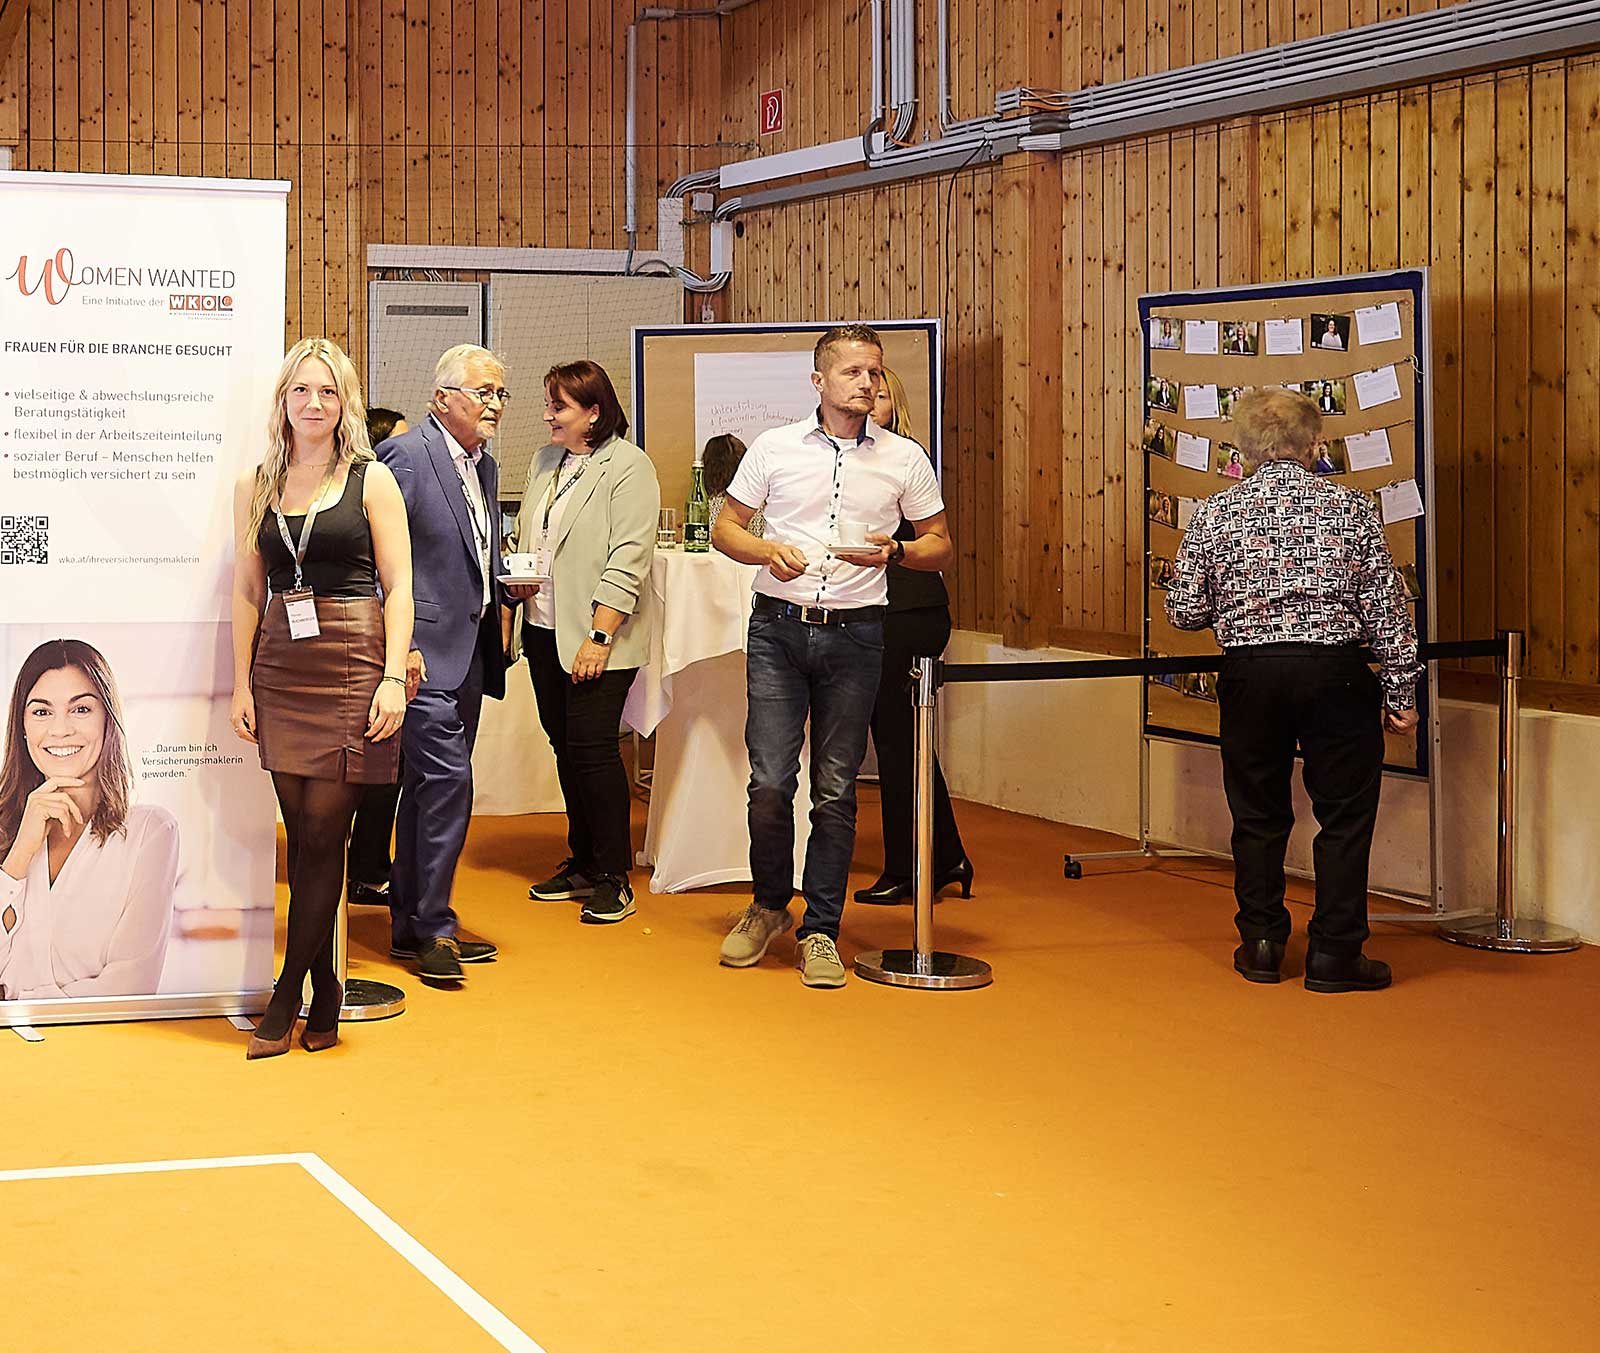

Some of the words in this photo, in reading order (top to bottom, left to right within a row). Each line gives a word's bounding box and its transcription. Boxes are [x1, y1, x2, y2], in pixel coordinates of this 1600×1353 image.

[5, 248, 142, 305] WOMEN
[148, 268, 235, 289] WANTED
[82, 295, 103, 306] Eine
[105, 295, 146, 307] Initiative
[148, 297, 164, 308] der
[4, 341, 56, 353] FRAUEN
[60, 339, 85, 354] FÜR
[88, 342, 109, 354] DIE
[112, 343, 172, 355] BRANCHE
[175, 344, 233, 356] GESUCHT
[14, 389, 75, 403] vielseitige
[79, 390, 88, 400] &
[92, 390, 214, 404] abwechslungsreiche
[14, 406, 126, 421] Beratungstätigkeit
[13, 428, 57, 441] flexibel
[61, 429, 72, 441] in
[75, 429, 96, 441] der
[99, 429, 222, 444] Arbeitszeiteinteilung
[13, 451, 61, 462] sozialer
[65, 450, 98, 462] Beruf
[112, 451, 173, 463] Menschen
[177, 451, 214, 463] helfen
[13, 467, 87, 482] bestmöglich
[90, 468, 151, 480] versichert
[154, 471, 168, 480] zu
[171, 469, 196, 480] sein
[189, 743, 202, 753] bin
[204, 743, 218, 752] ich
[141, 755, 243, 766] Versicherungsmaklerin
